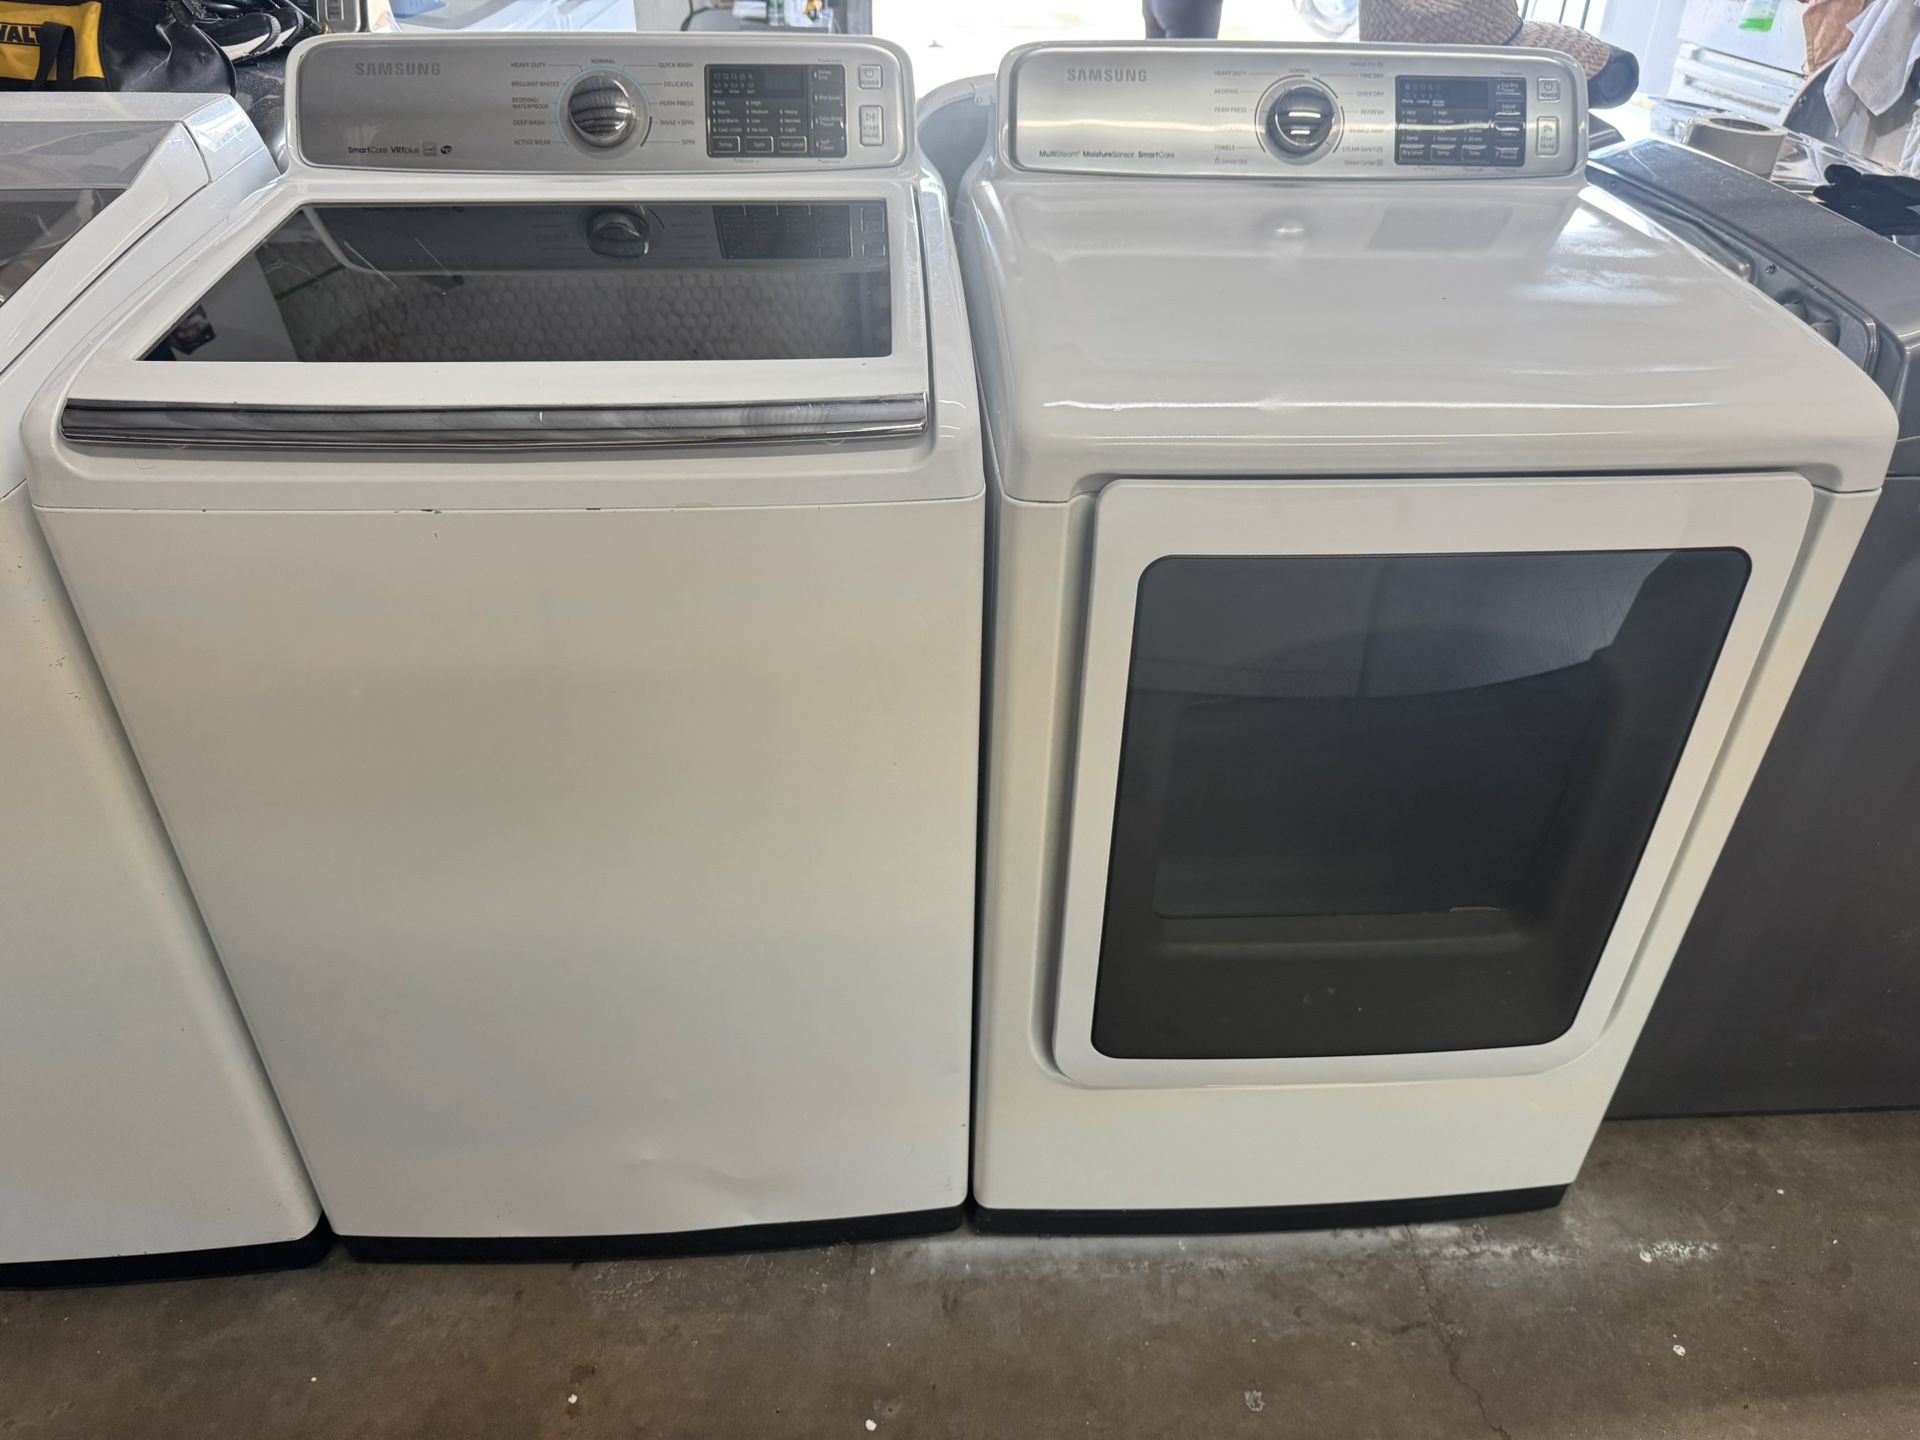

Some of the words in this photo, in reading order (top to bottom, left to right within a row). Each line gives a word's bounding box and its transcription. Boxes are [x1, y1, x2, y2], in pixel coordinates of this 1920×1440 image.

[355, 62, 442, 76] SAMSUNG
[1067, 68, 1147, 82] SAMSUNG
[1083, 150, 1134, 158] MoistureSensor
[1138, 150, 1176, 159] SmartCare
